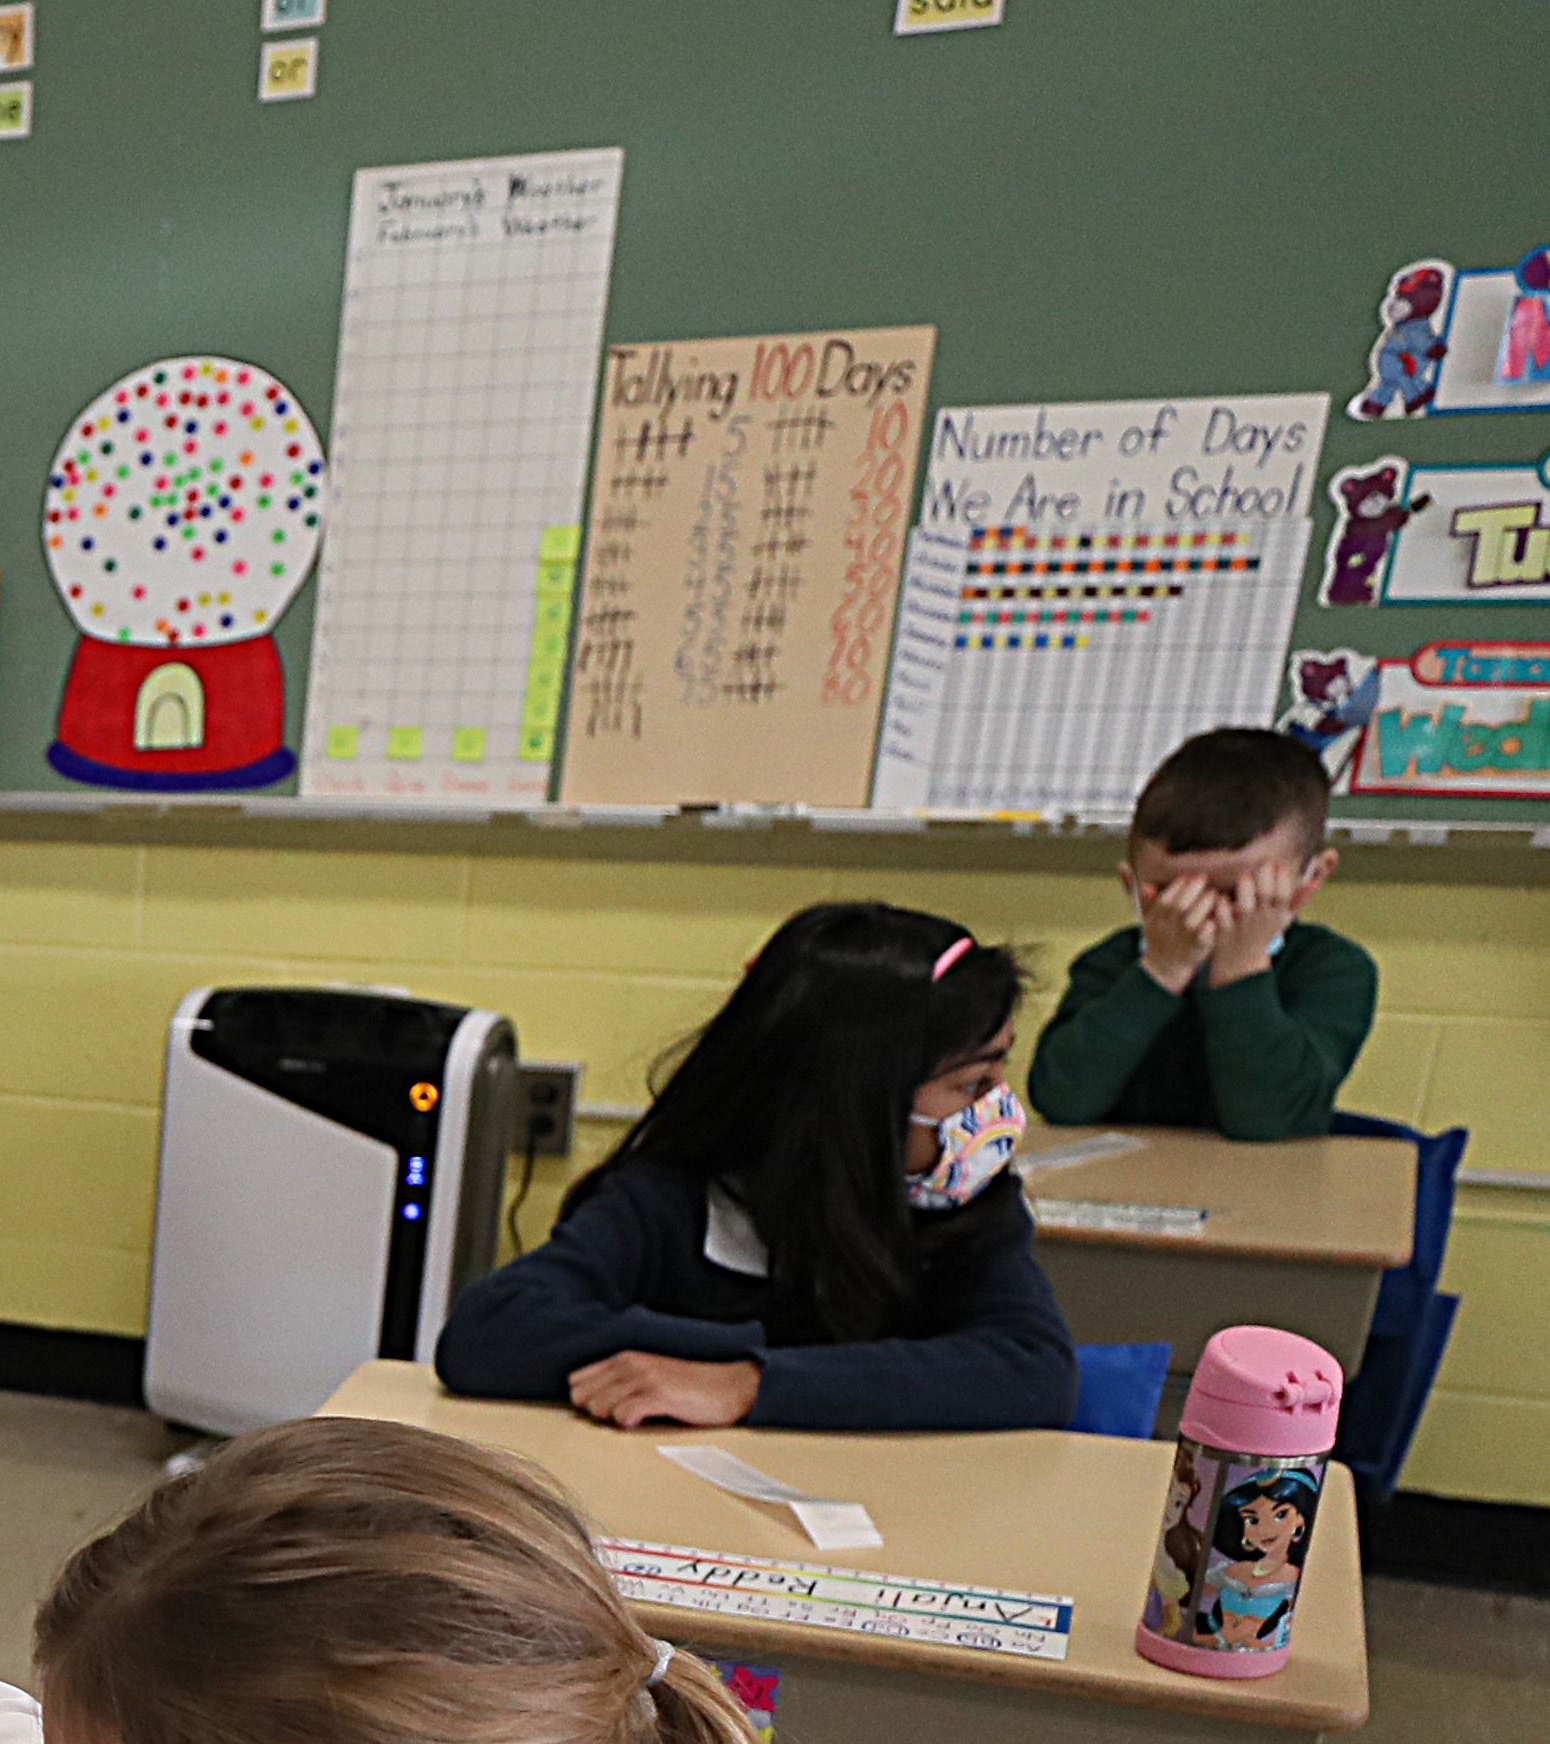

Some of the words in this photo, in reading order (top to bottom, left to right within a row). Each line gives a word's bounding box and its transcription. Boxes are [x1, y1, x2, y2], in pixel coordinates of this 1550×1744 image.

[608, 347, 740, 423] Tallying
[750, 341, 816, 401] 100
[817, 337, 916, 405] Days
[867, 400, 910, 451] 10
[937, 408, 1105, 465] Number
[1116, 404, 1179, 455] of
[1202, 406, 1309, 468] Days
[927, 476, 994, 522] We
[1002, 471, 1083, 522] Are
[1105, 477, 1145, 517] in
[1164, 461, 1304, 521] School
[675, 1557, 820, 1598] Reddy
[877, 1586, 1034, 1623] Anjali
